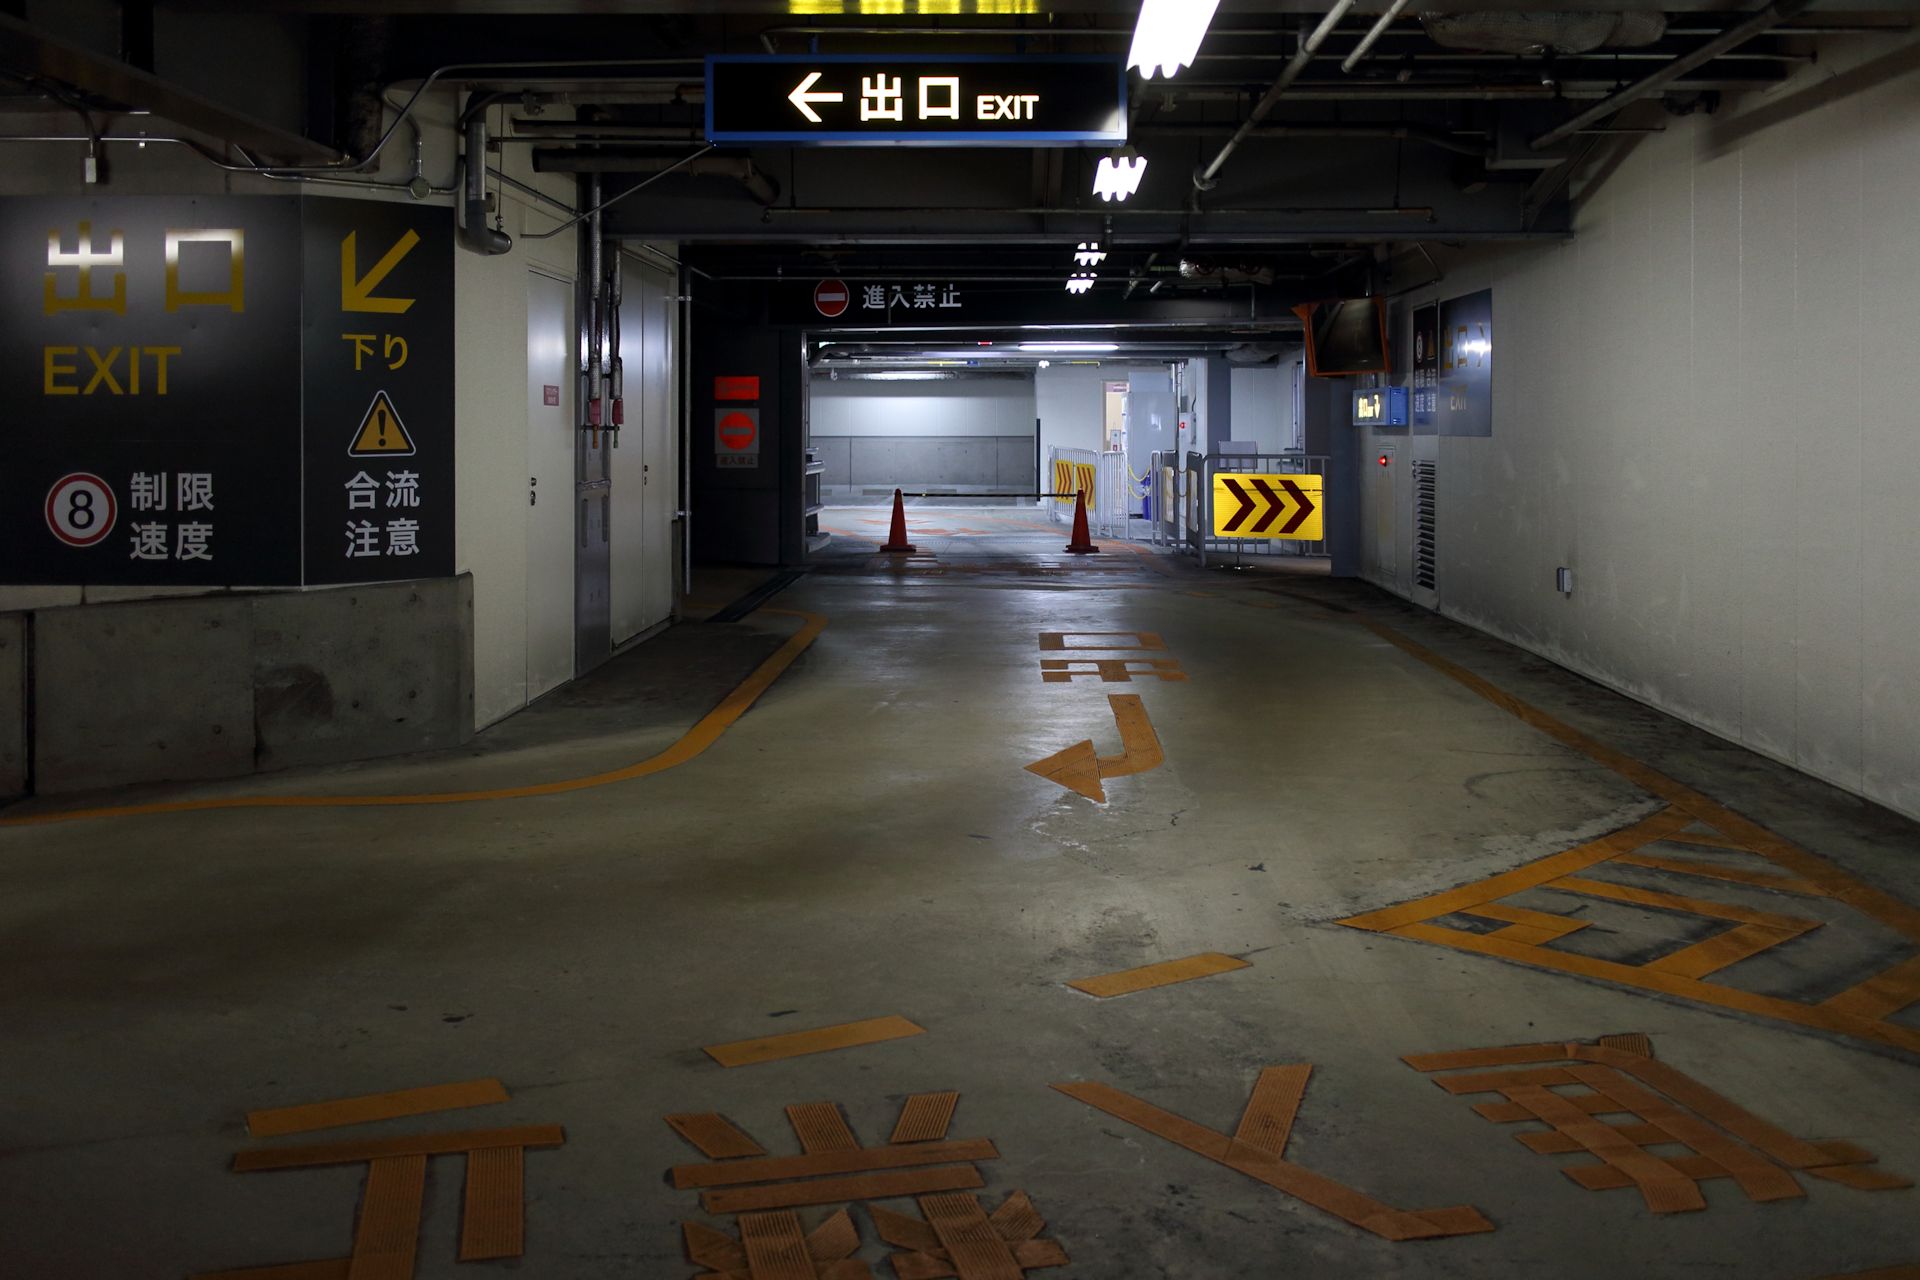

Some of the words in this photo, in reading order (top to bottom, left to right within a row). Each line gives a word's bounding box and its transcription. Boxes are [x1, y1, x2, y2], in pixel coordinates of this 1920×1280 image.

[859, 71, 962, 123] 出口
[975, 93, 1040, 121] EXIT
[43, 220, 246, 316] 出口
[861, 283, 963, 311] 進入禁止
[43, 345, 182, 395] EXIT
[341, 333, 409, 371] 下り
[129, 471, 215, 512] 制限
[344, 470, 420, 509] 合流
[68, 490, 94, 530] 8
[129, 520, 214, 562] 速度
[344, 519, 420, 559] 注意
